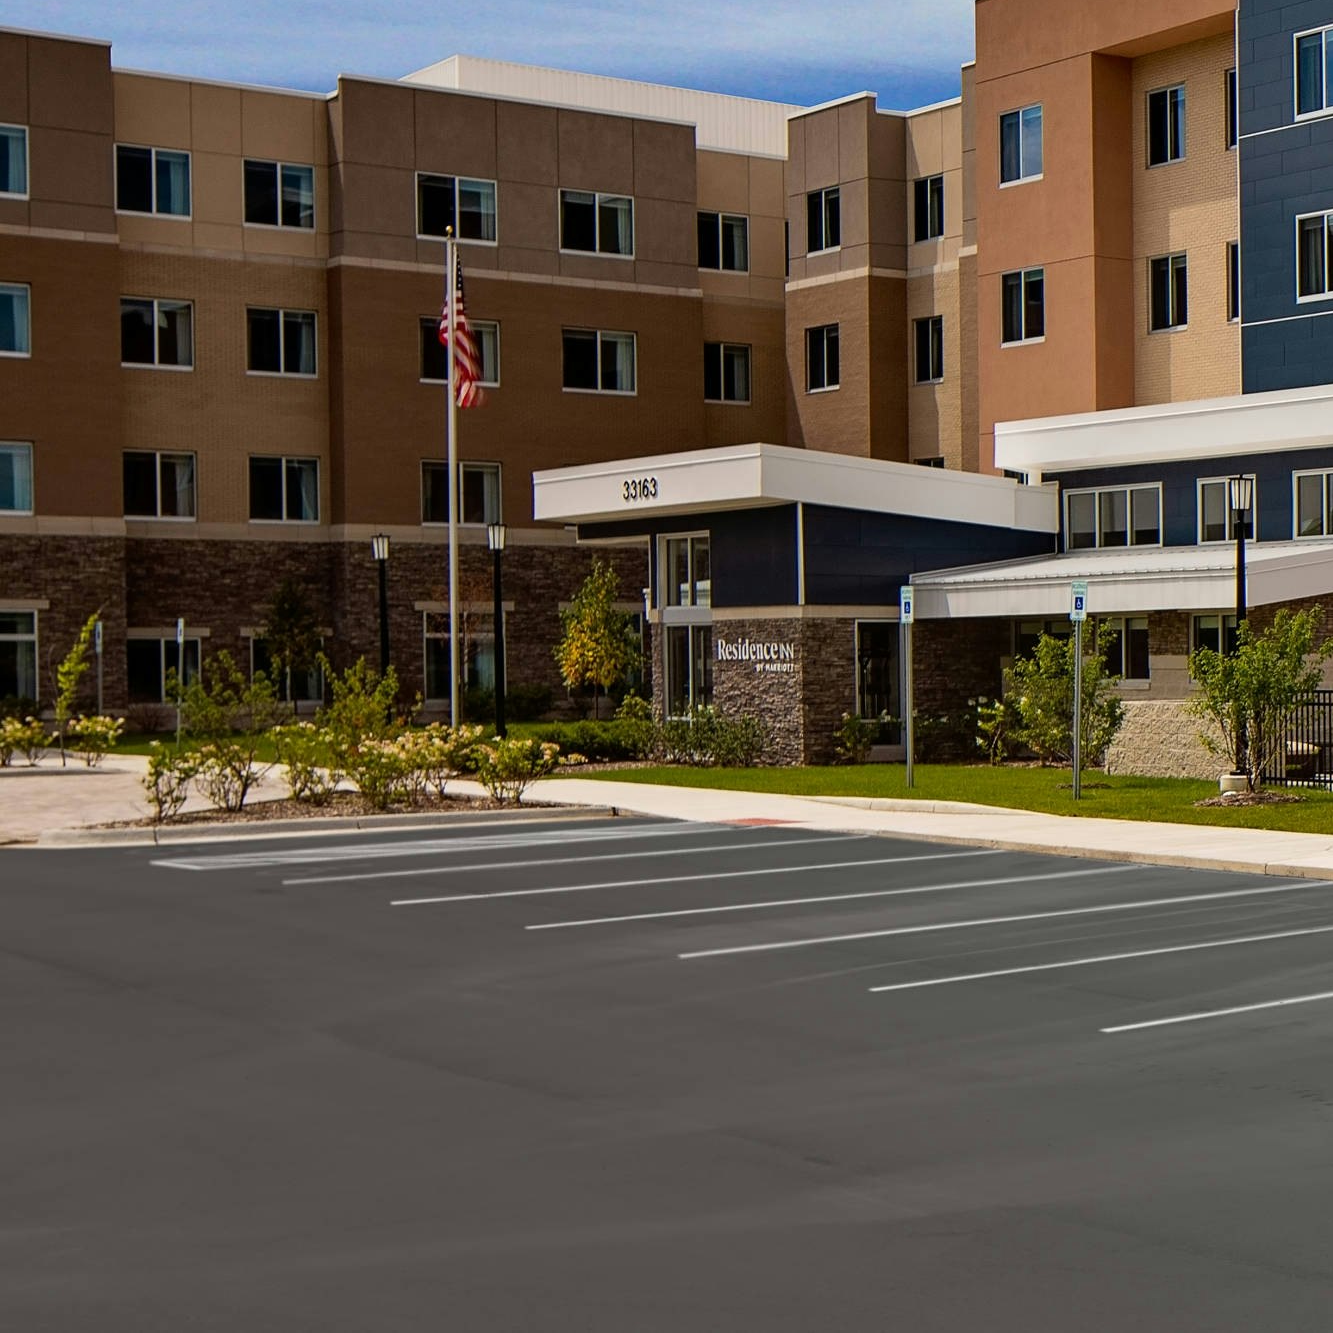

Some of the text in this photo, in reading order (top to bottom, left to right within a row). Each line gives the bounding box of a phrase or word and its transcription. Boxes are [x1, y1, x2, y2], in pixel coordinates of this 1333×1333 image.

[623, 477, 657, 500] 33163
[718, 637, 794, 661] Residence INN
